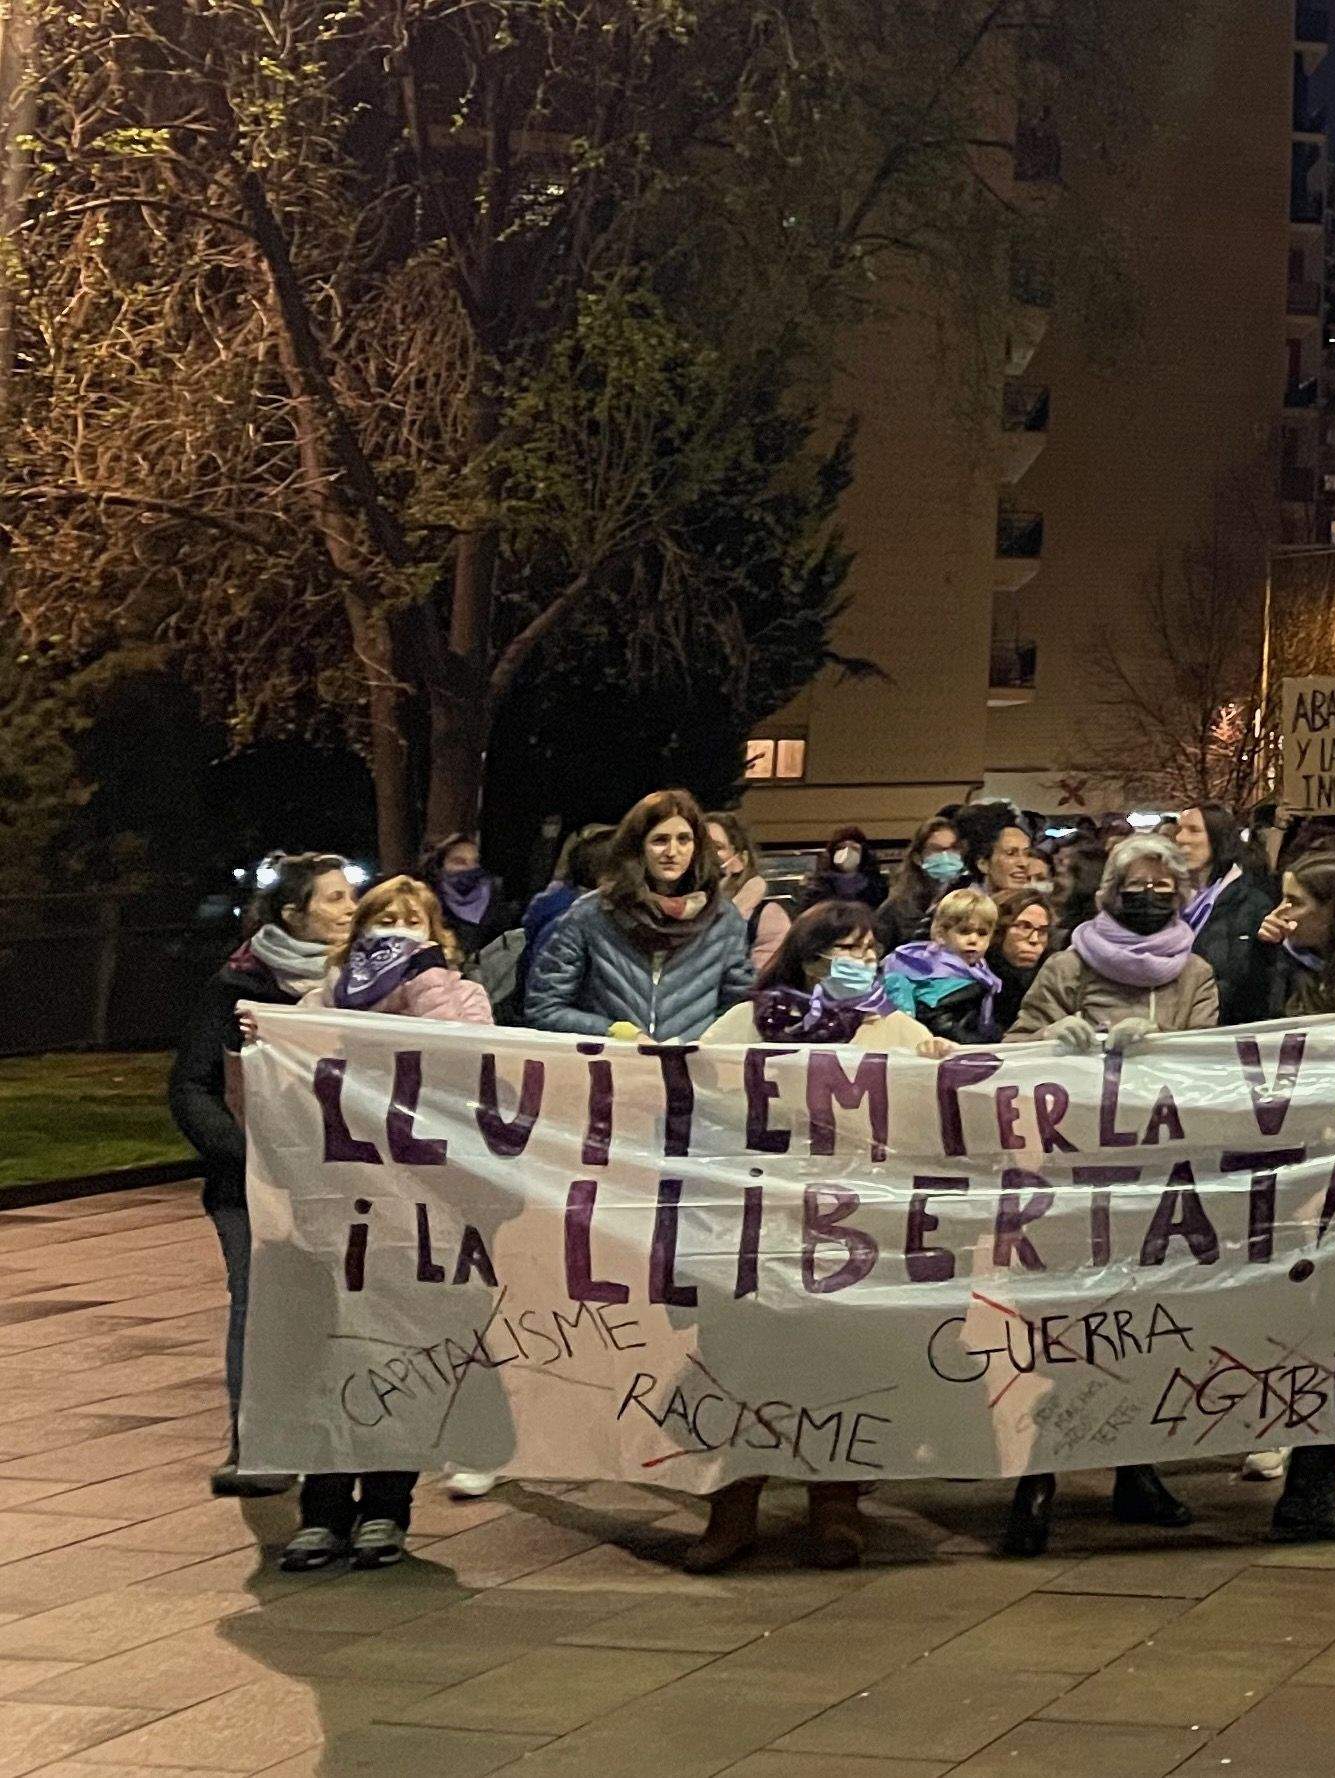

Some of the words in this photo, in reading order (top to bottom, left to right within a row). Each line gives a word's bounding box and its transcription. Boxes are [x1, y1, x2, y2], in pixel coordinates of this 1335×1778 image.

[1297, 738, 1312, 771] Y
[415, 1203, 499, 1287] LA
[927, 1301, 1195, 1383] GUERRA
[617, 1371, 892, 1469] RACISME
